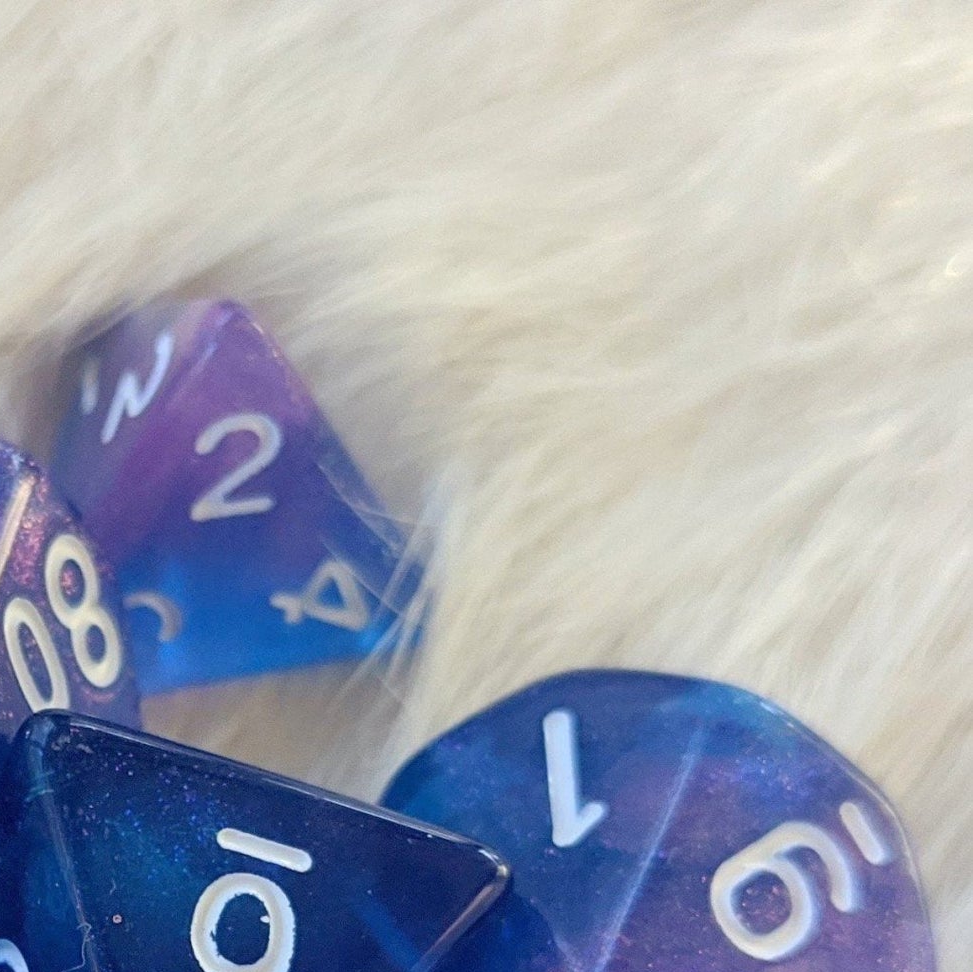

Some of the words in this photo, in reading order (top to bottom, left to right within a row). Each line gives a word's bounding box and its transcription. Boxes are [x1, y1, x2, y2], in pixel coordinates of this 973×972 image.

[190, 412, 283, 522] 2
[3, 534, 121, 714] 80
[270, 558, 370, 632] 4
[542, 709, 607, 847] 1
